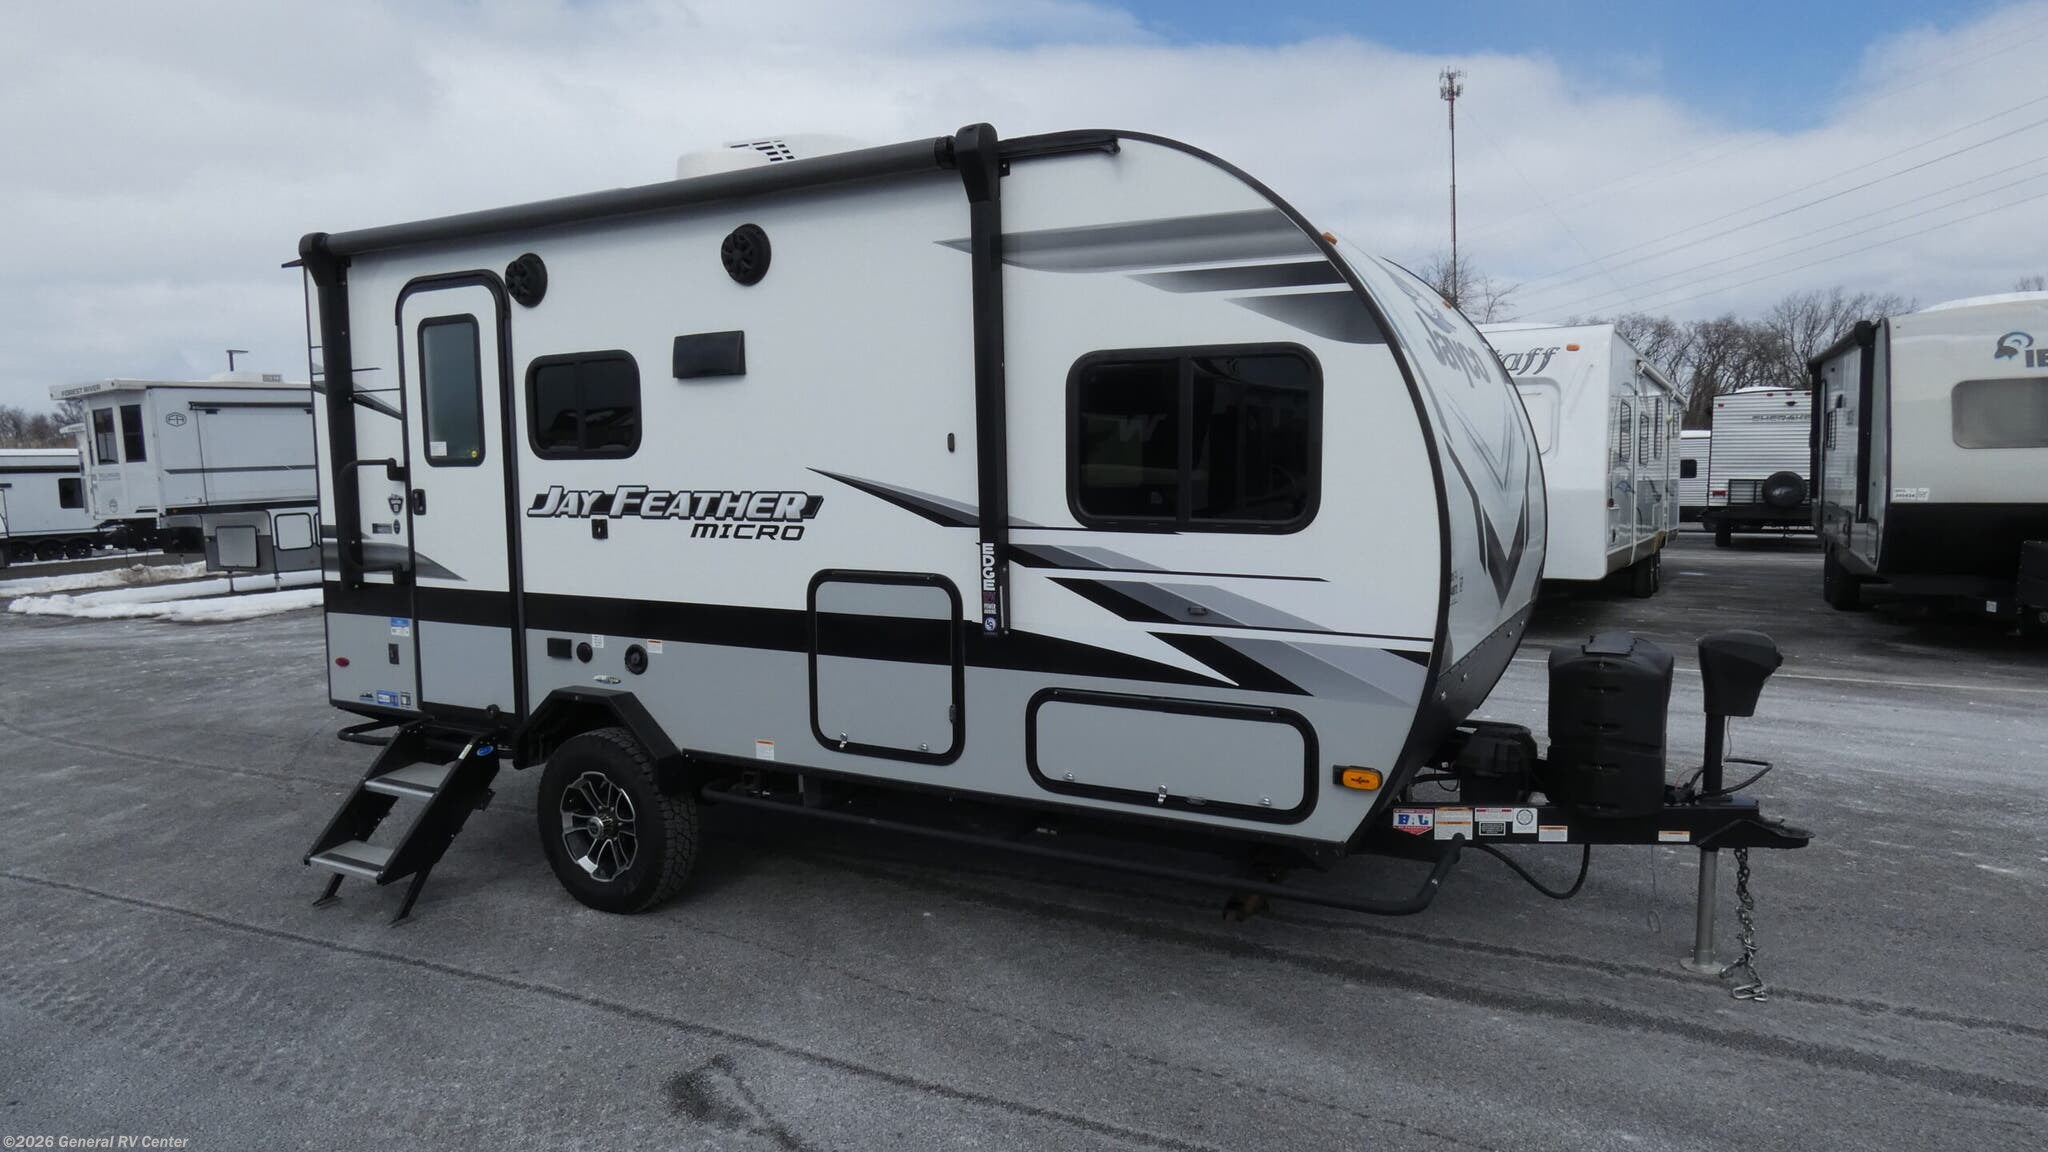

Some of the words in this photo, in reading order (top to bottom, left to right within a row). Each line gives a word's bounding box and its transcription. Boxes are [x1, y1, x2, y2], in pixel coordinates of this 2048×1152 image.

[1414, 310, 1492, 388] Jayco
[1497, 346, 1561, 376] aff
[61, 387, 83, 396] FOREST
[84, 384, 102, 393] RIVER
[527, 485, 604, 518] JAY
[608, 485, 808, 522] FEATHER
[690, 523, 805, 541] MICRO
[982, 542, 996, 591] EDGE
